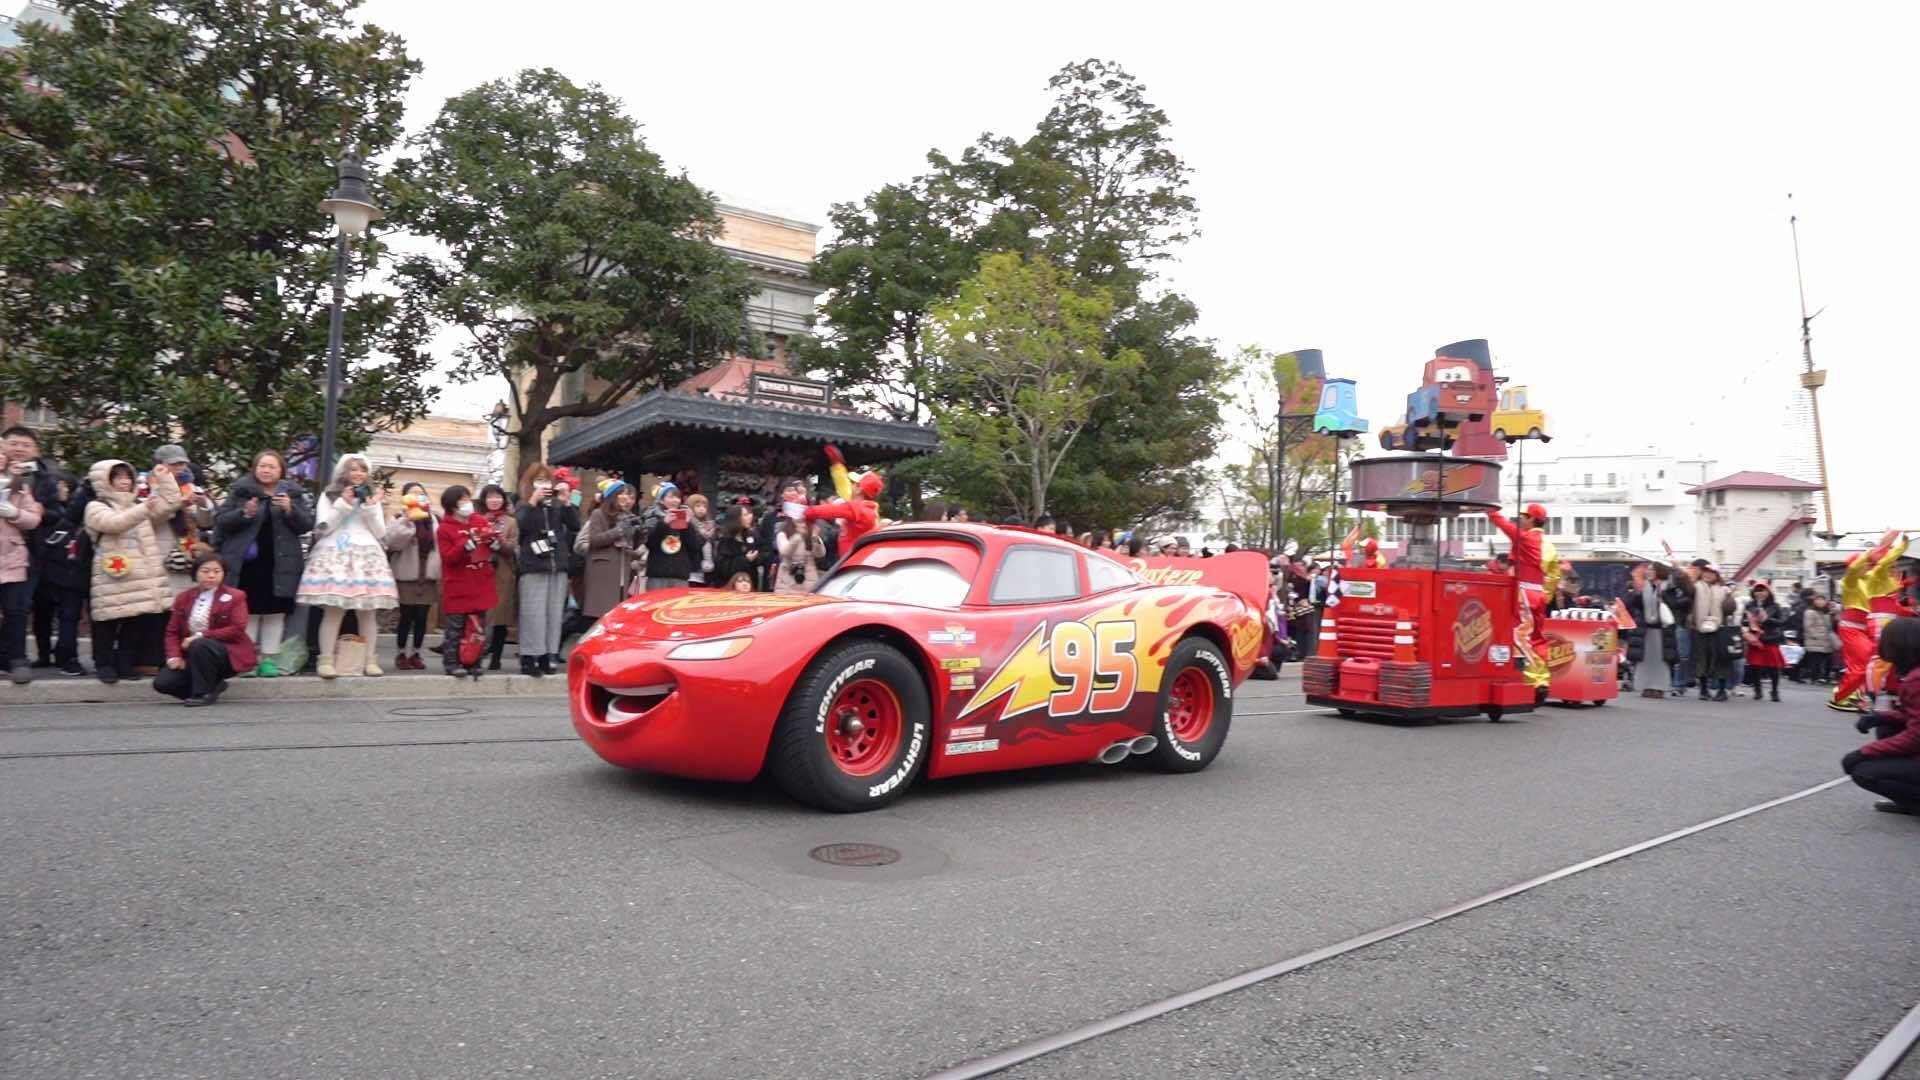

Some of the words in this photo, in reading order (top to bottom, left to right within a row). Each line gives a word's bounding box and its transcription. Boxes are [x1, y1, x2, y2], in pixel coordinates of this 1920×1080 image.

[816, 659, 876, 733] LIGHTYEAR
[1048, 620, 1137, 717] 95
[1195, 650, 1231, 698] LIGHTYEAR
[869, 722, 924, 797] LIGHTYEAR
